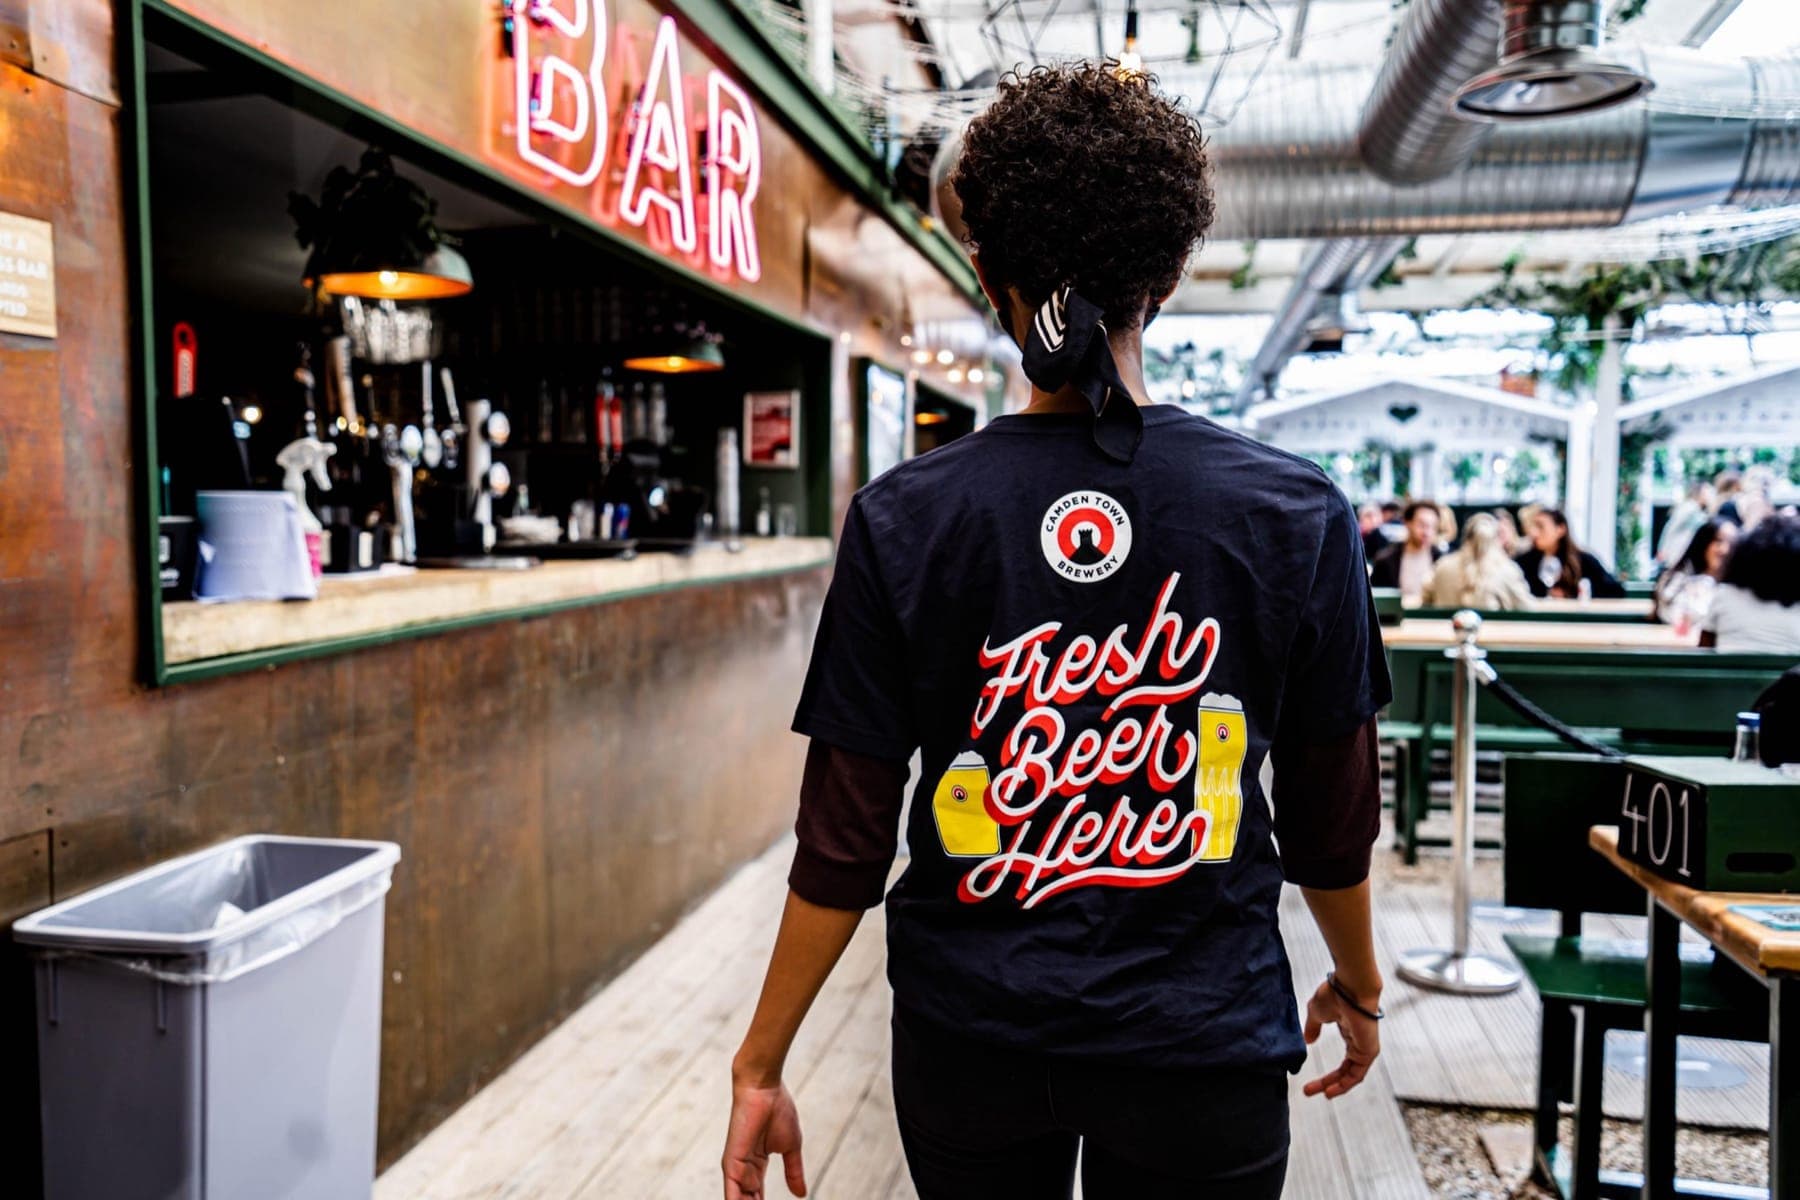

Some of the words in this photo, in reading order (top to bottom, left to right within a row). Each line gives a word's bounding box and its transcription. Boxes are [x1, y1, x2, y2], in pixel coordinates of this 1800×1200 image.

[515, 0, 762, 282] BAR
[17, 256, 48, 281] BAR
[1046, 496, 1089, 533] CAMDEN
[1095, 497, 1125, 526] TOWN
[1057, 555, 1118, 578] BREWERY
[970, 571, 1221, 739] Fresh
[983, 704, 1197, 826] Beer
[957, 794, 1213, 910] Here
[1621, 772, 1692, 878] 401
